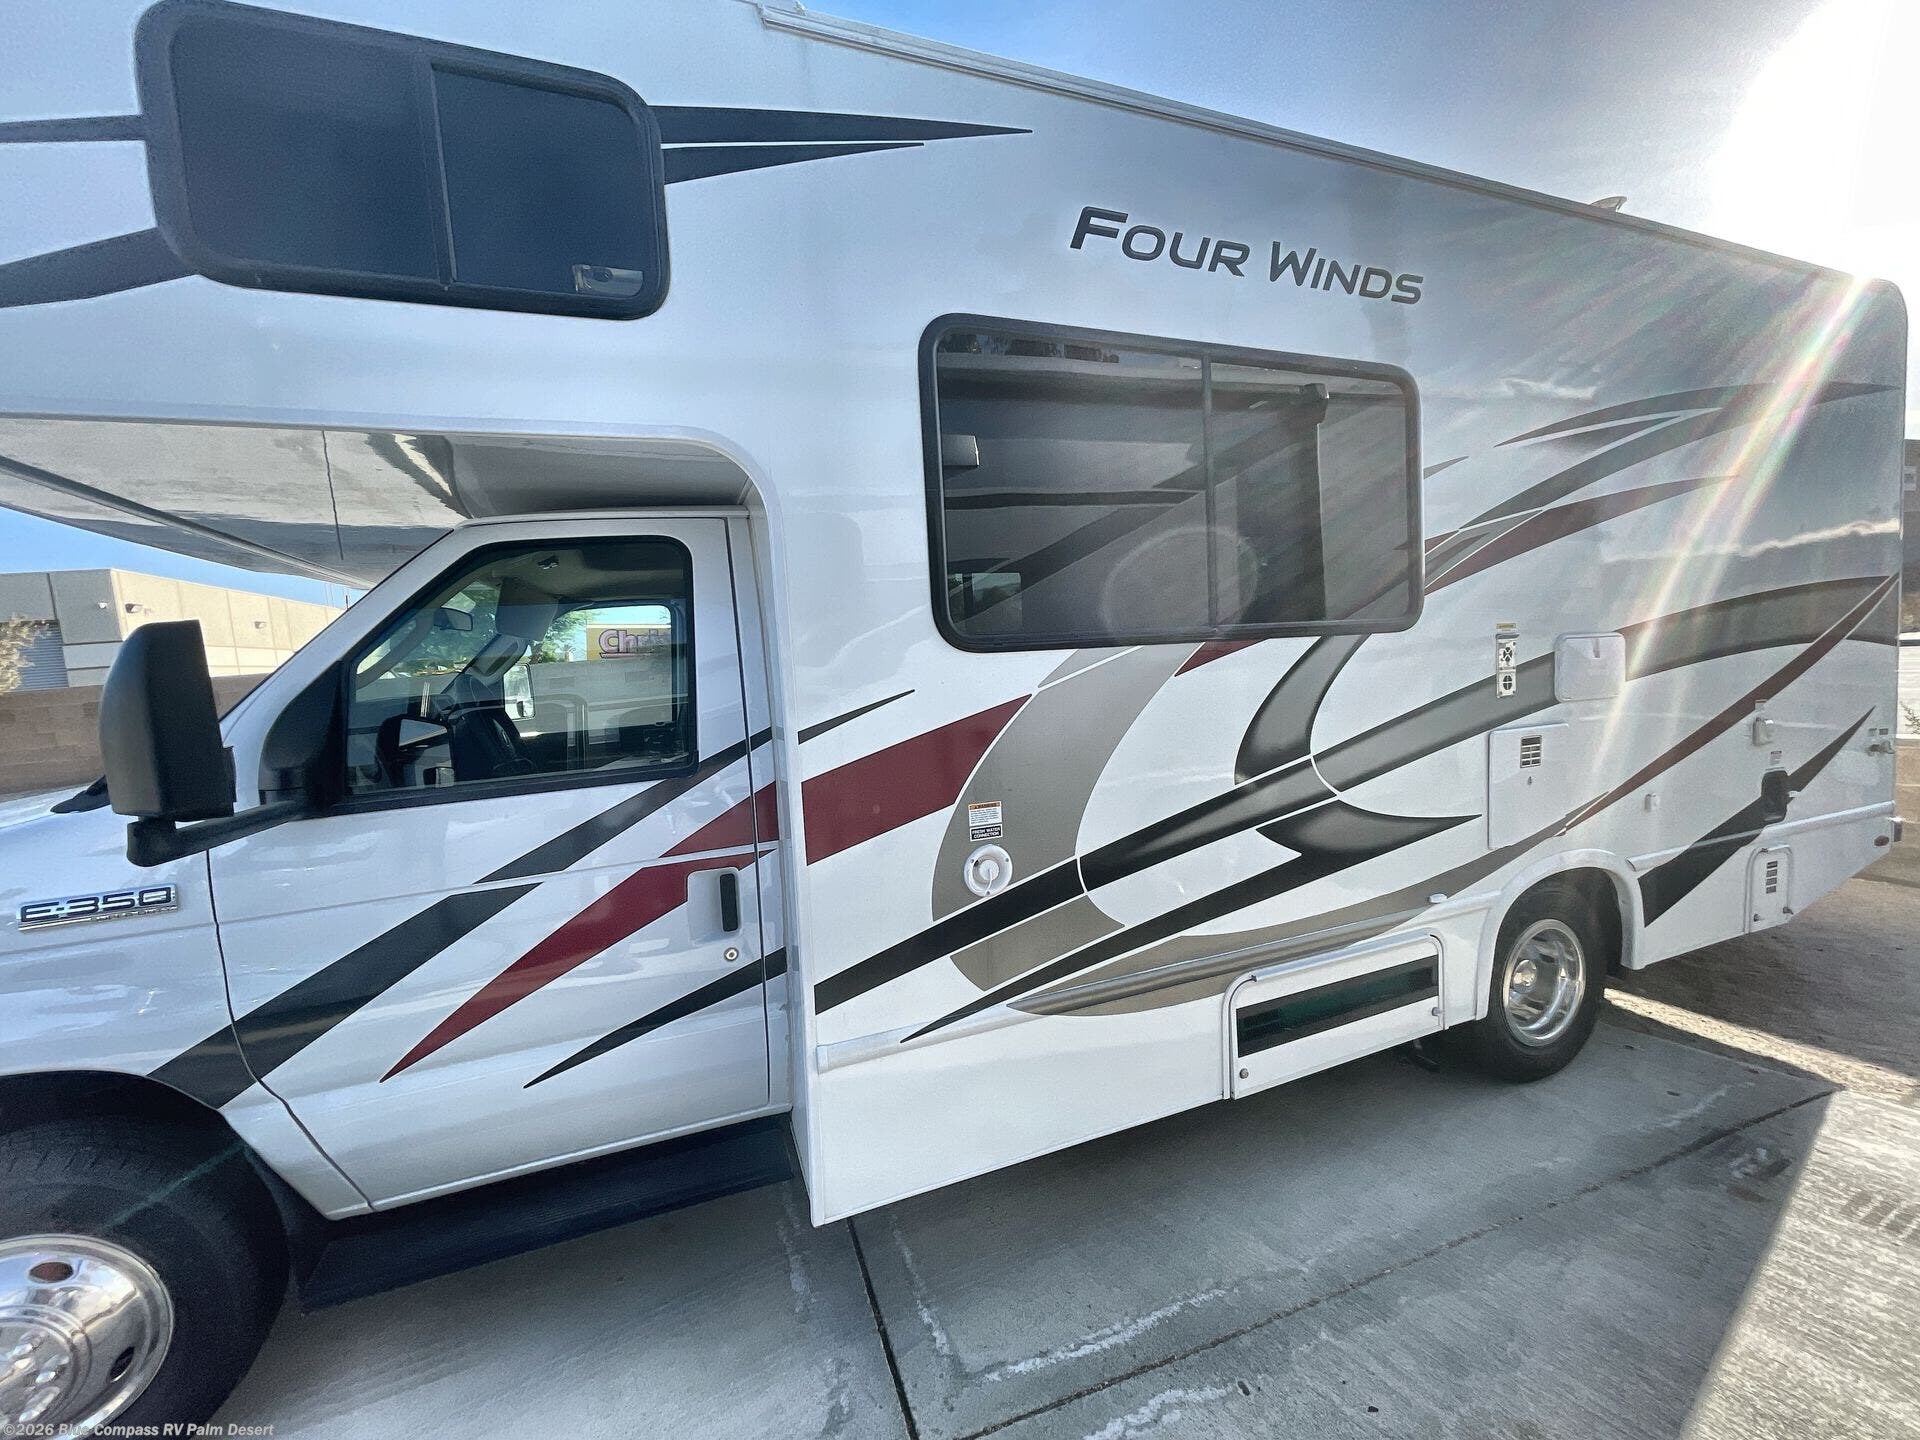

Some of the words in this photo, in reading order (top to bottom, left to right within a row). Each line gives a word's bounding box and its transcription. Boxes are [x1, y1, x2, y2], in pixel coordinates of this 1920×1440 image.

[1069, 205, 1251, 278] FOUR
[1268, 240, 1425, 305] WINDS
[20, 887, 172, 922] E-350
